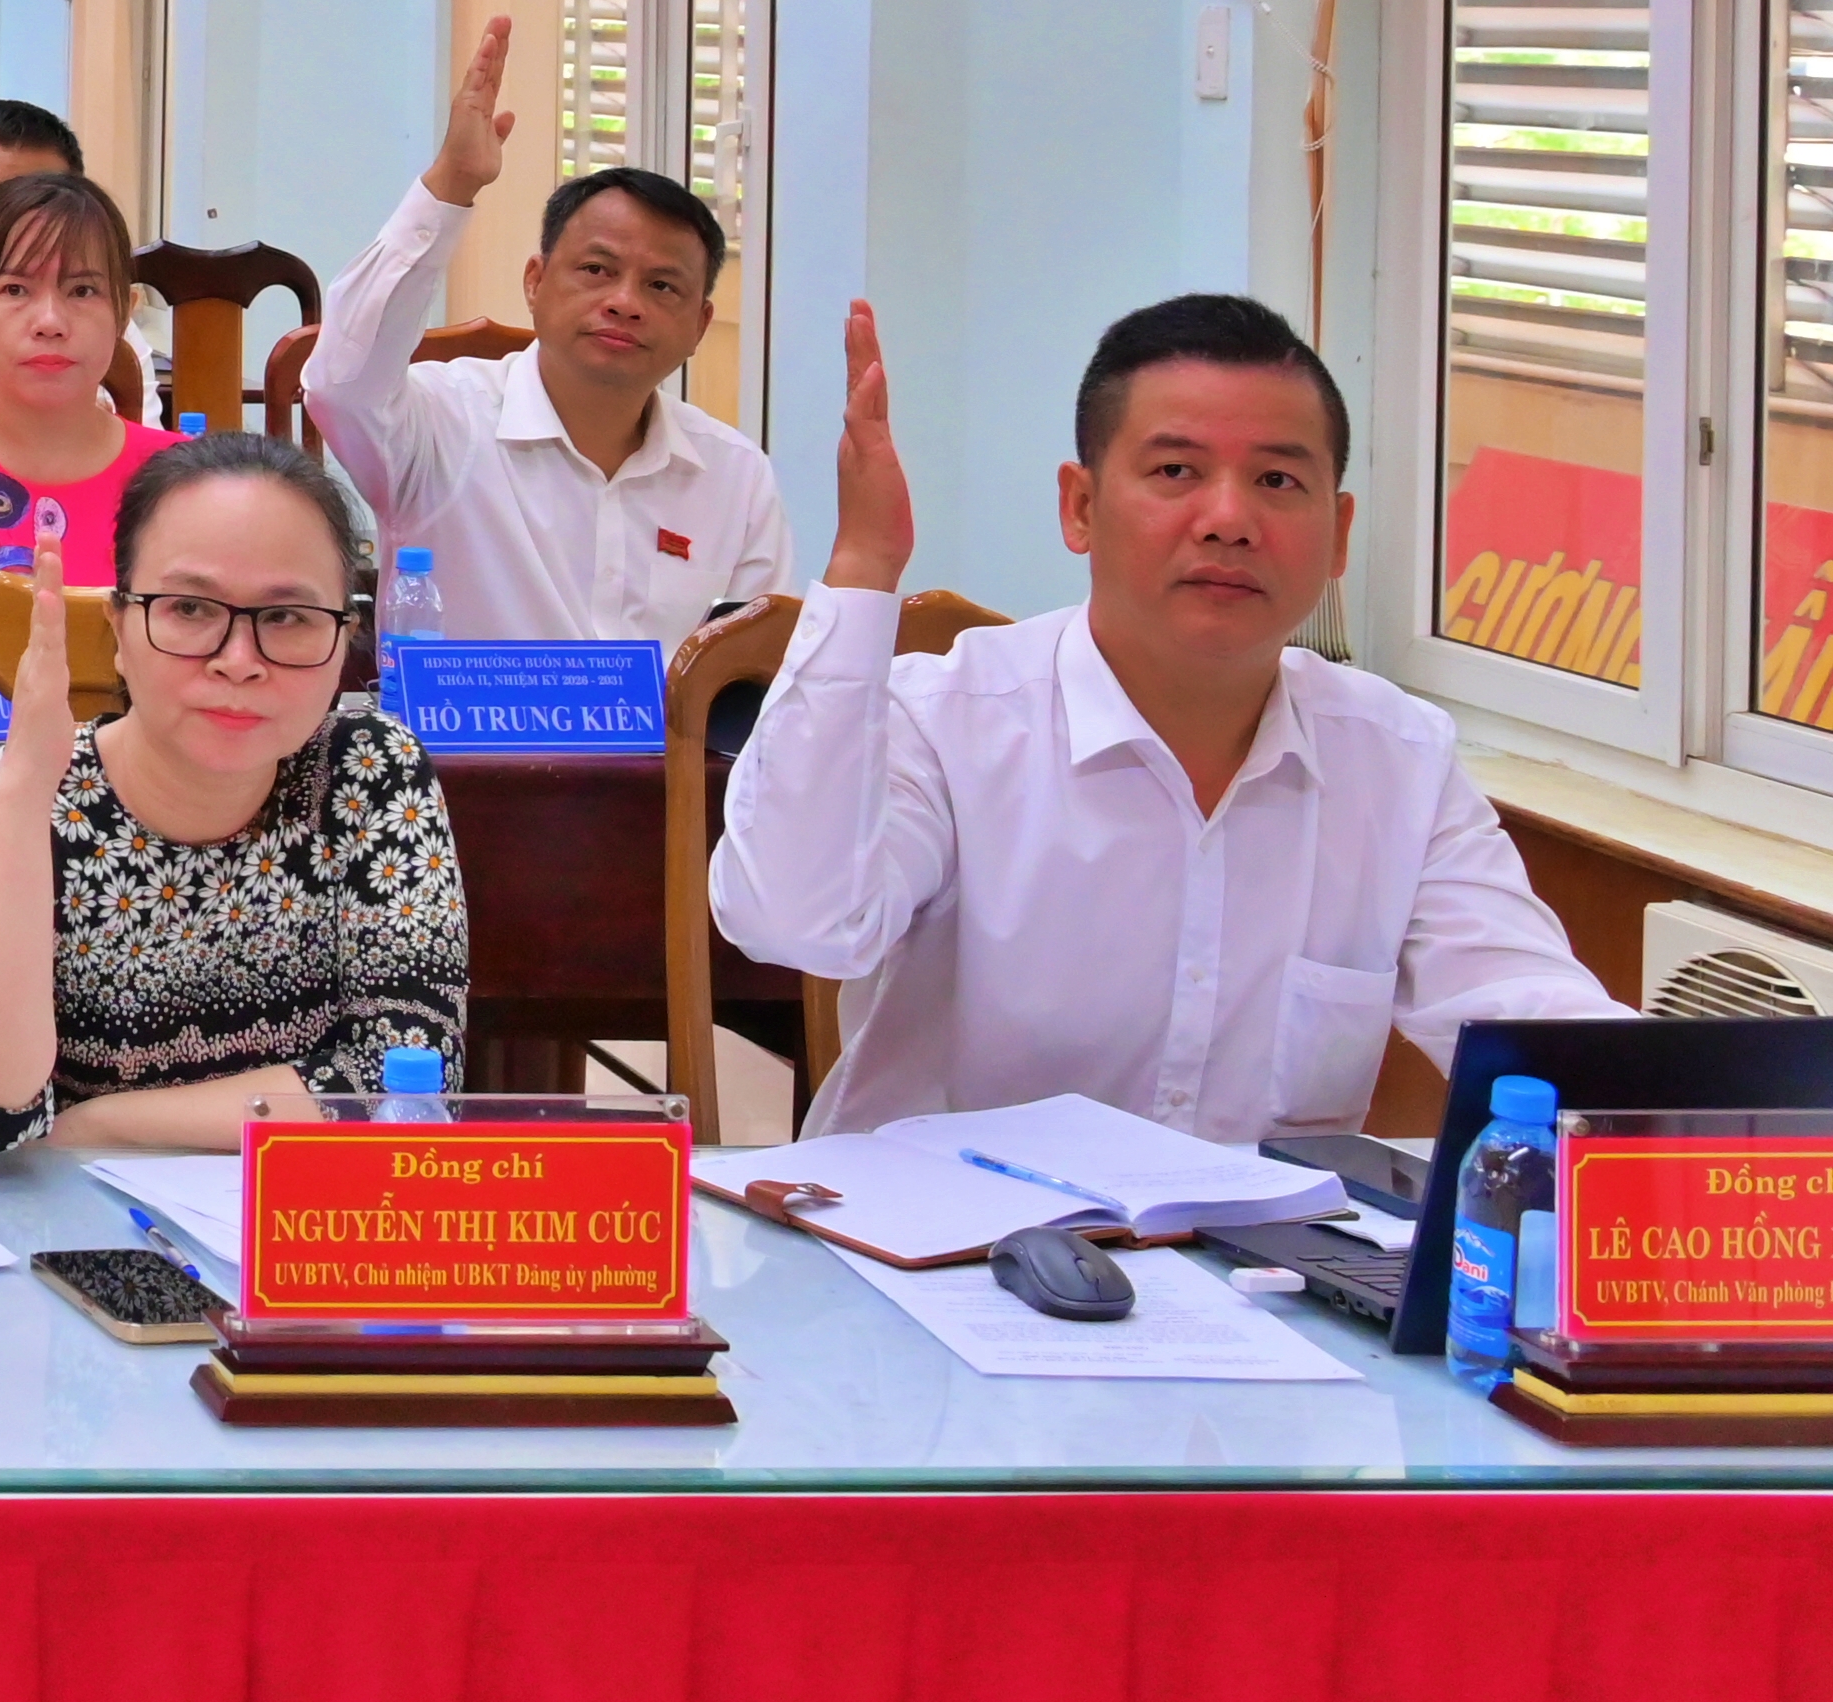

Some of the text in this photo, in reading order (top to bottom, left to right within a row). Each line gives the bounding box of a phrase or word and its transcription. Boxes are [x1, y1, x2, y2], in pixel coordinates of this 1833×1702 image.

[423, 653, 633, 671] HĐND PHƯỜNG BUÔN MA THUỘT
[436, 671, 475, 686] KHÓA
[494, 671, 539, 688] NHIỆM
[561, 675, 589, 686] 2026
[597, 675, 624, 686] 2031
[467, 706, 573, 732] TRUNG
[579, 697, 654, 732] KIÊN
[391, 1147, 544, 1185] Đồng chí
[1706, 1163, 1797, 1201] Đồng
[271, 1192, 662, 1251] NGUYỄN THỊ KIM CÚC
[1588, 1210, 1822, 1260] LÊ CAO HỒNG
[274, 1262, 658, 1293] UVBTV, Chủ nhiệm UBKT Đảng ủy phường
[1596, 1279, 1825, 1309] UVBTV, Chánh Văn phòng
